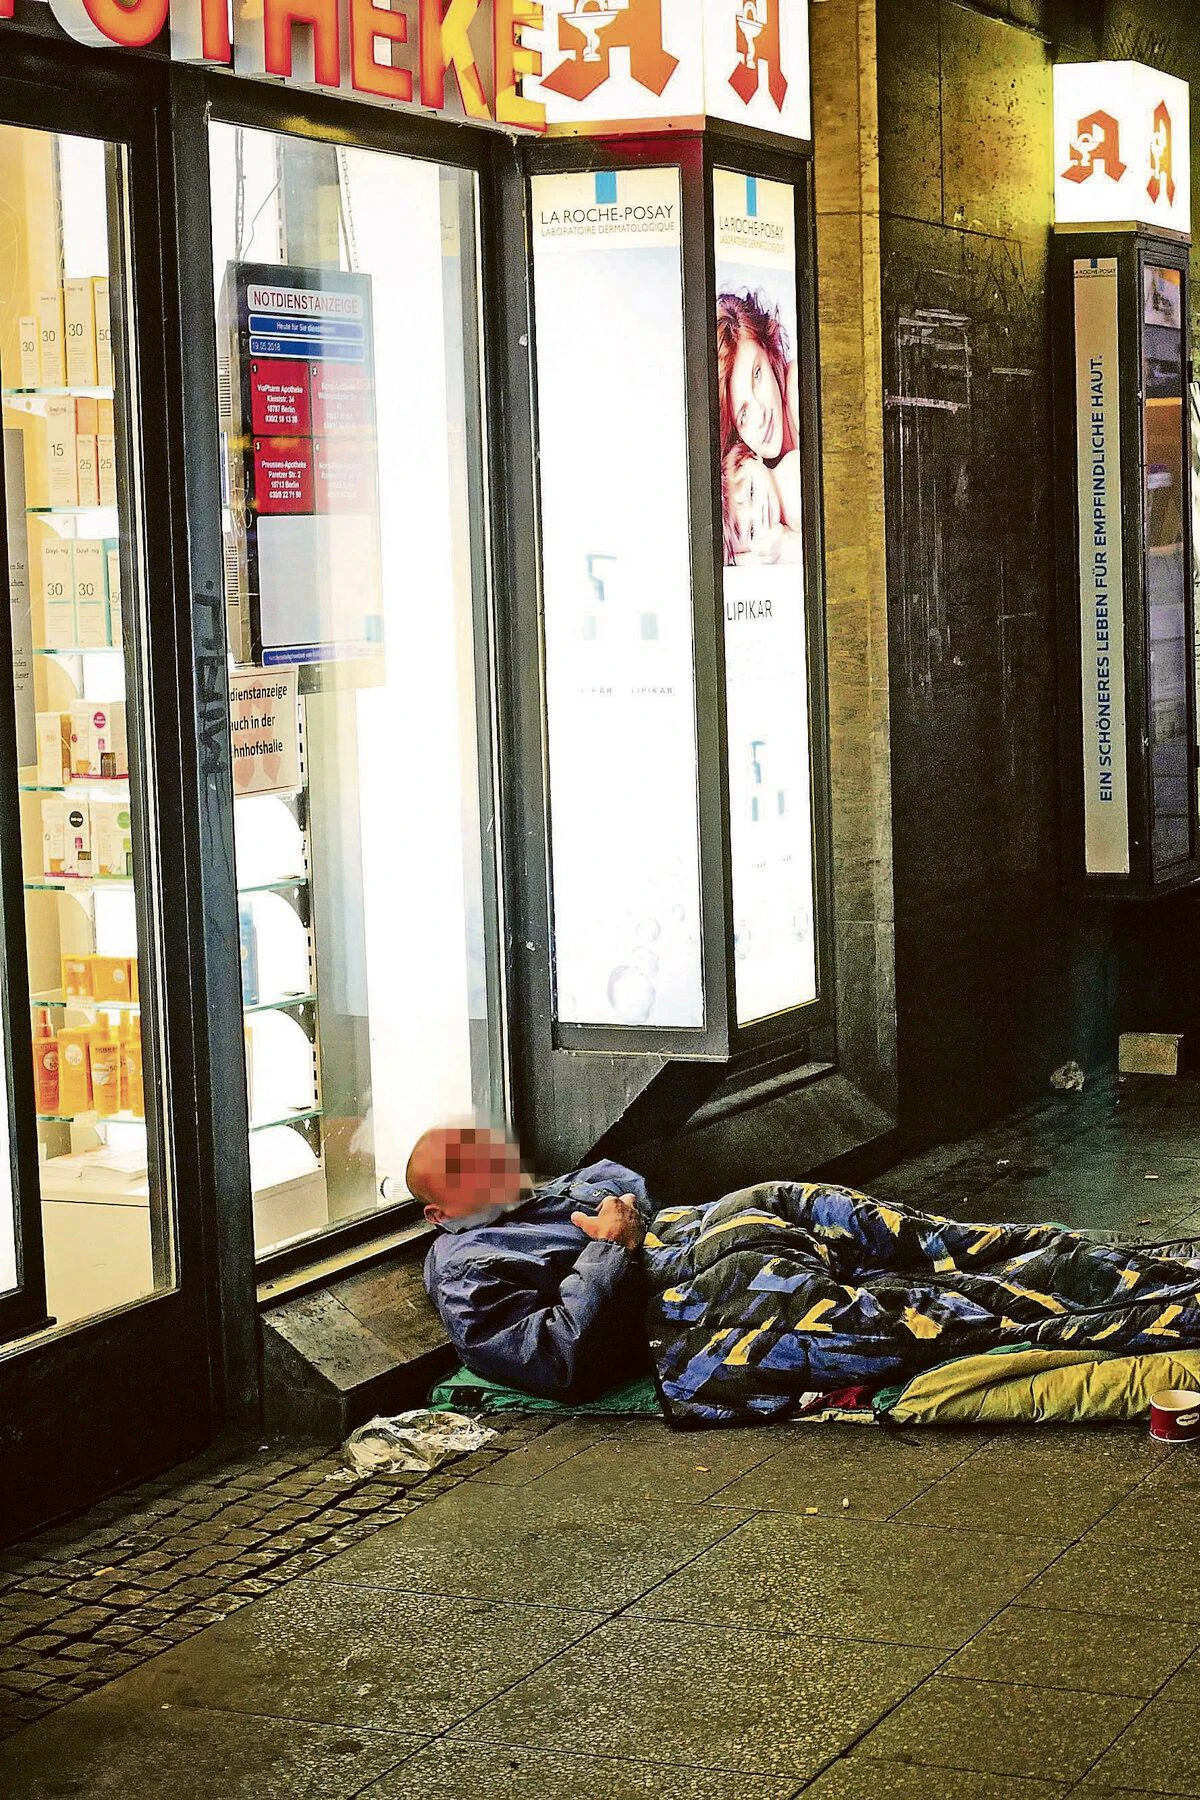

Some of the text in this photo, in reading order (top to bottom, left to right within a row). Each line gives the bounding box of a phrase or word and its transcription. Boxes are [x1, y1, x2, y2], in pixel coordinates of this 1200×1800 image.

[0, 0, 547, 131] HEKE
[541, 205, 674, 224] LA ROCHE-POSAY
[719, 216, 784, 239] LA ROCHE-POSAY
[254, 291, 358, 314] NOTDIENSTANZEIGE
[42, 330, 56, 342] 30
[68, 323, 83, 336] 30
[22, 341, 34, 352] 30
[51, 443, 64, 456] 15
[80, 459, 91, 470] 25
[100, 458, 112, 470] 25
[1090, 355, 1112, 802] EIN SCHÖNERES LEBEN FÜR EMPFINDLICHE HAUT.
[47, 583, 63, 596] 30
[78, 583, 94, 596] 30
[726, 599, 773, 621] LIPIKAR
[251, 714, 259, 729] in
[261, 713, 275, 727] der
[232, 738, 283, 758] hnhofshalle
